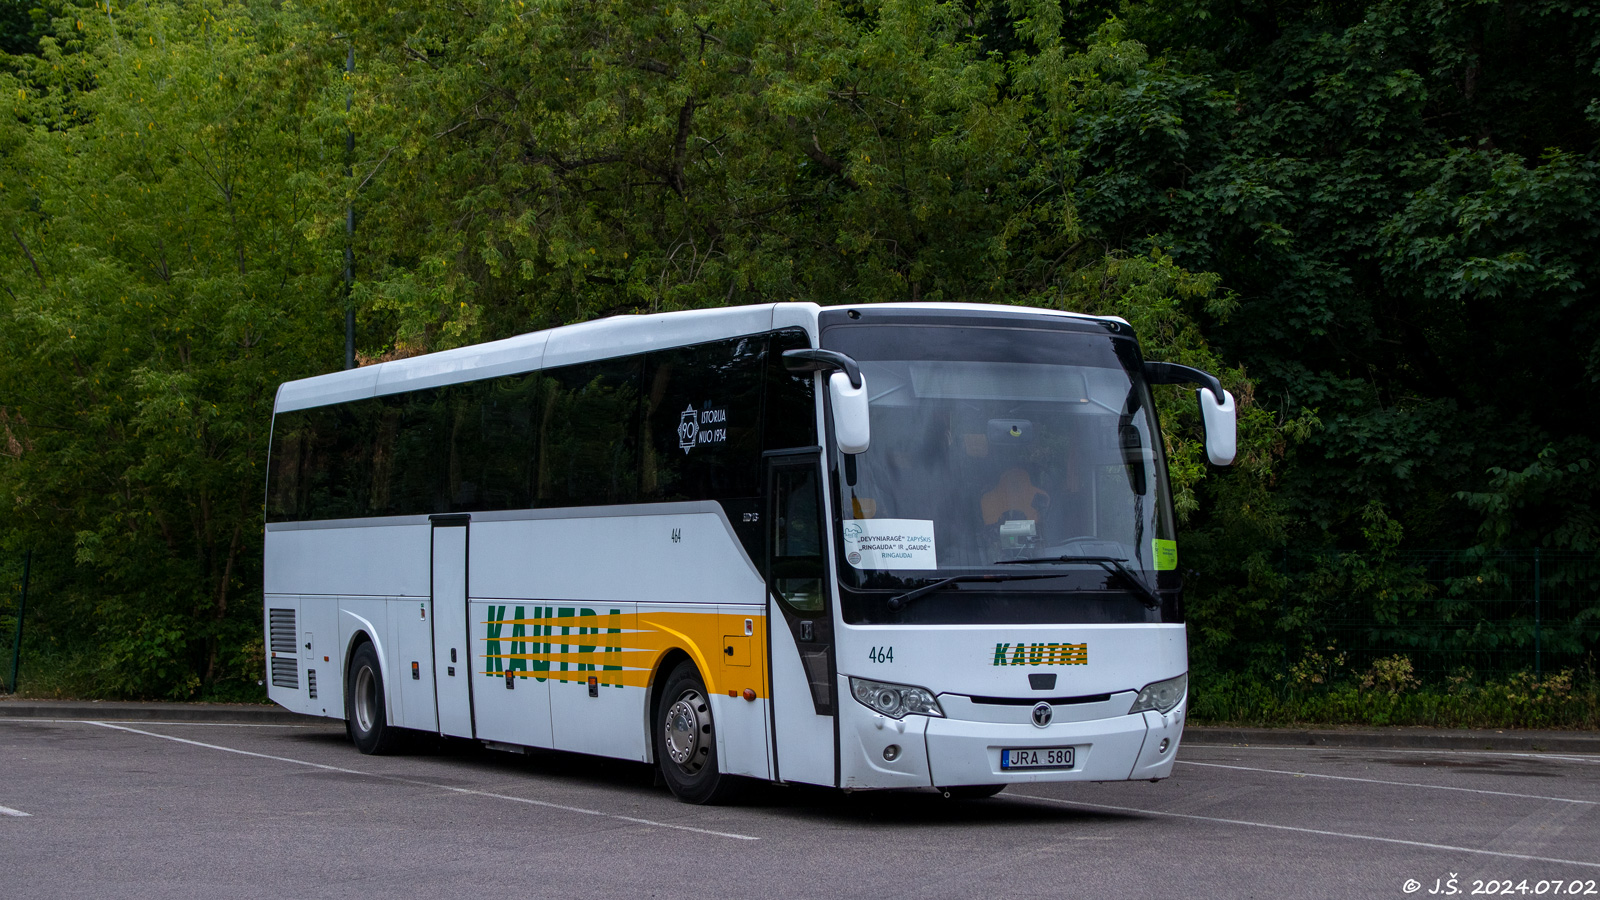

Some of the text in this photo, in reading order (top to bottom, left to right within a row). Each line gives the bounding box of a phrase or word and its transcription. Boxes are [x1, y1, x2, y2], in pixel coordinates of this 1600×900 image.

[702, 410, 726, 424] ISTORIJA
[682, 422, 694, 438] 90
[698, 428, 727, 443] NUO 1934
[671, 528, 681, 543] 464
[906, 535, 932, 543] ZAPYŠKIS
[485, 605, 624, 689] KAUTRA
[994, 643, 1088, 666] KAUTRA
[869, 646, 894, 664] 464
[1010, 750, 1072, 765] JRA 580
